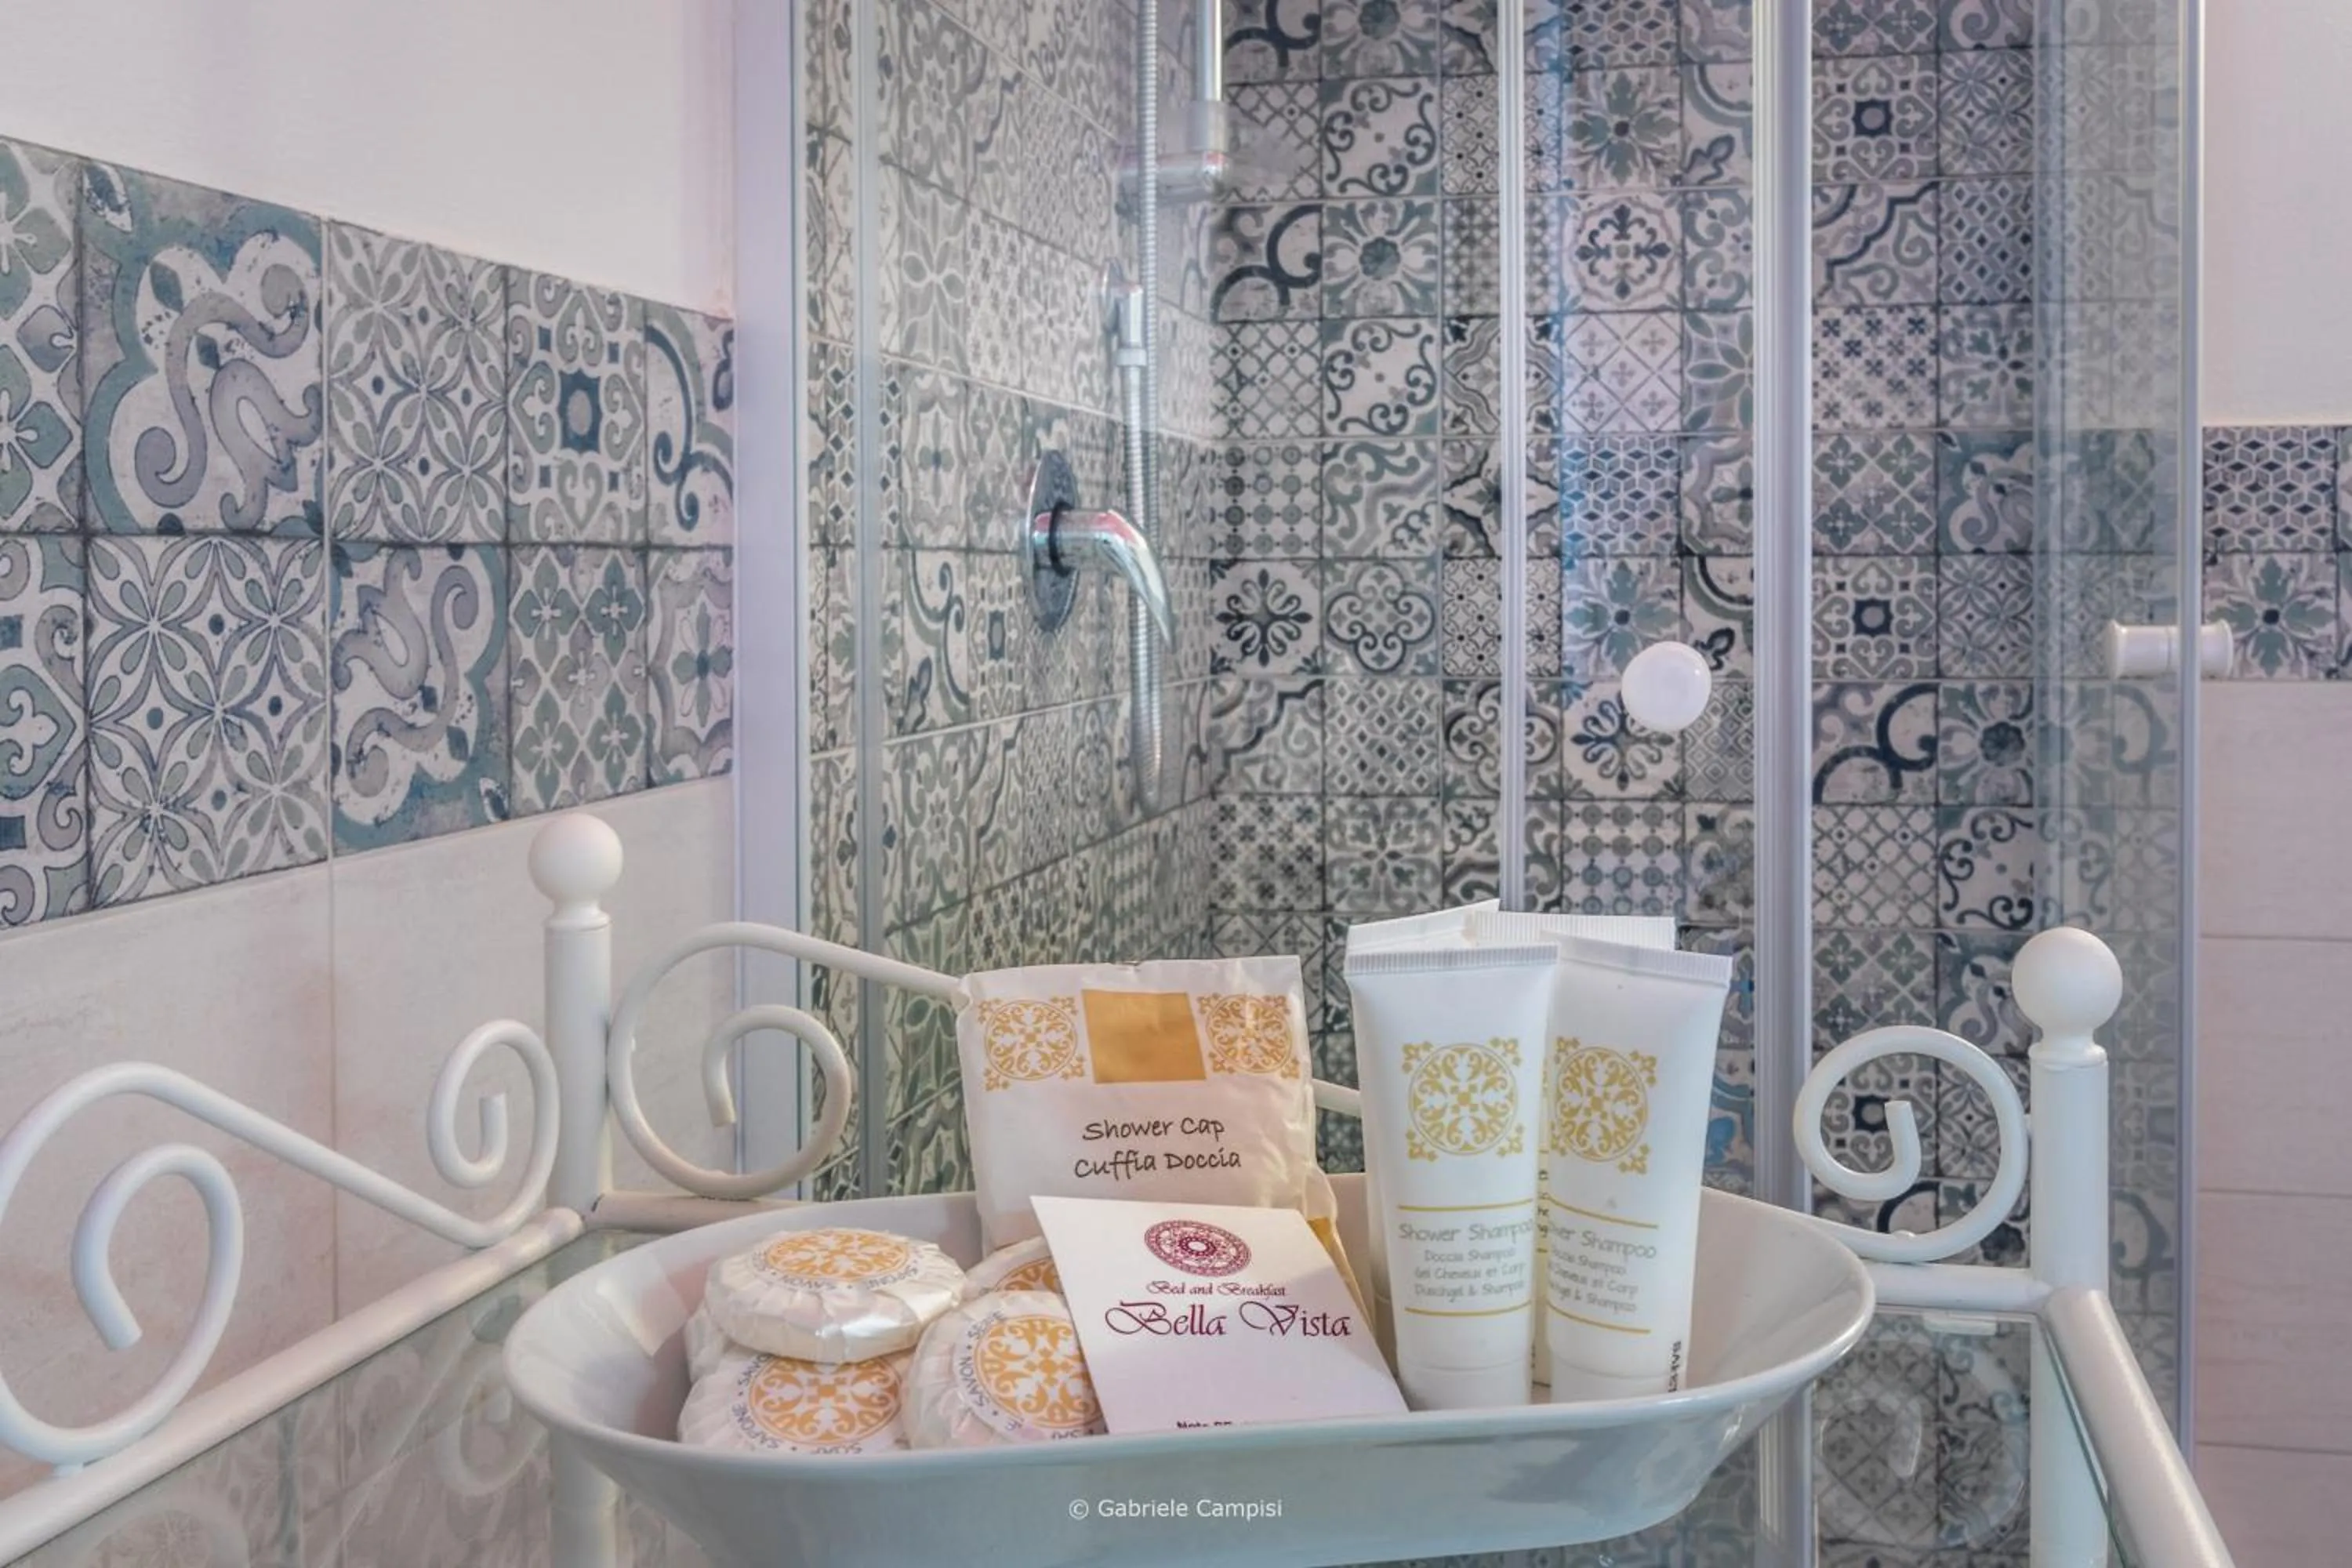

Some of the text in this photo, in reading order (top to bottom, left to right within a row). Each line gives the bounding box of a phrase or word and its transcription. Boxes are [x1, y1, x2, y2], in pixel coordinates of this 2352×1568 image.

[1082, 1116, 1225, 1142] Shower Cap
[1074, 1147, 1242, 1181] Cuffia Doccia
[1398, 1222, 1461, 1242] Shower
[1580, 1230, 1657, 1263] Shampoo
[1146, 1280, 1287, 1300] Bed and Breakfast
[1105, 1300, 1352, 1337] Bella Vista
